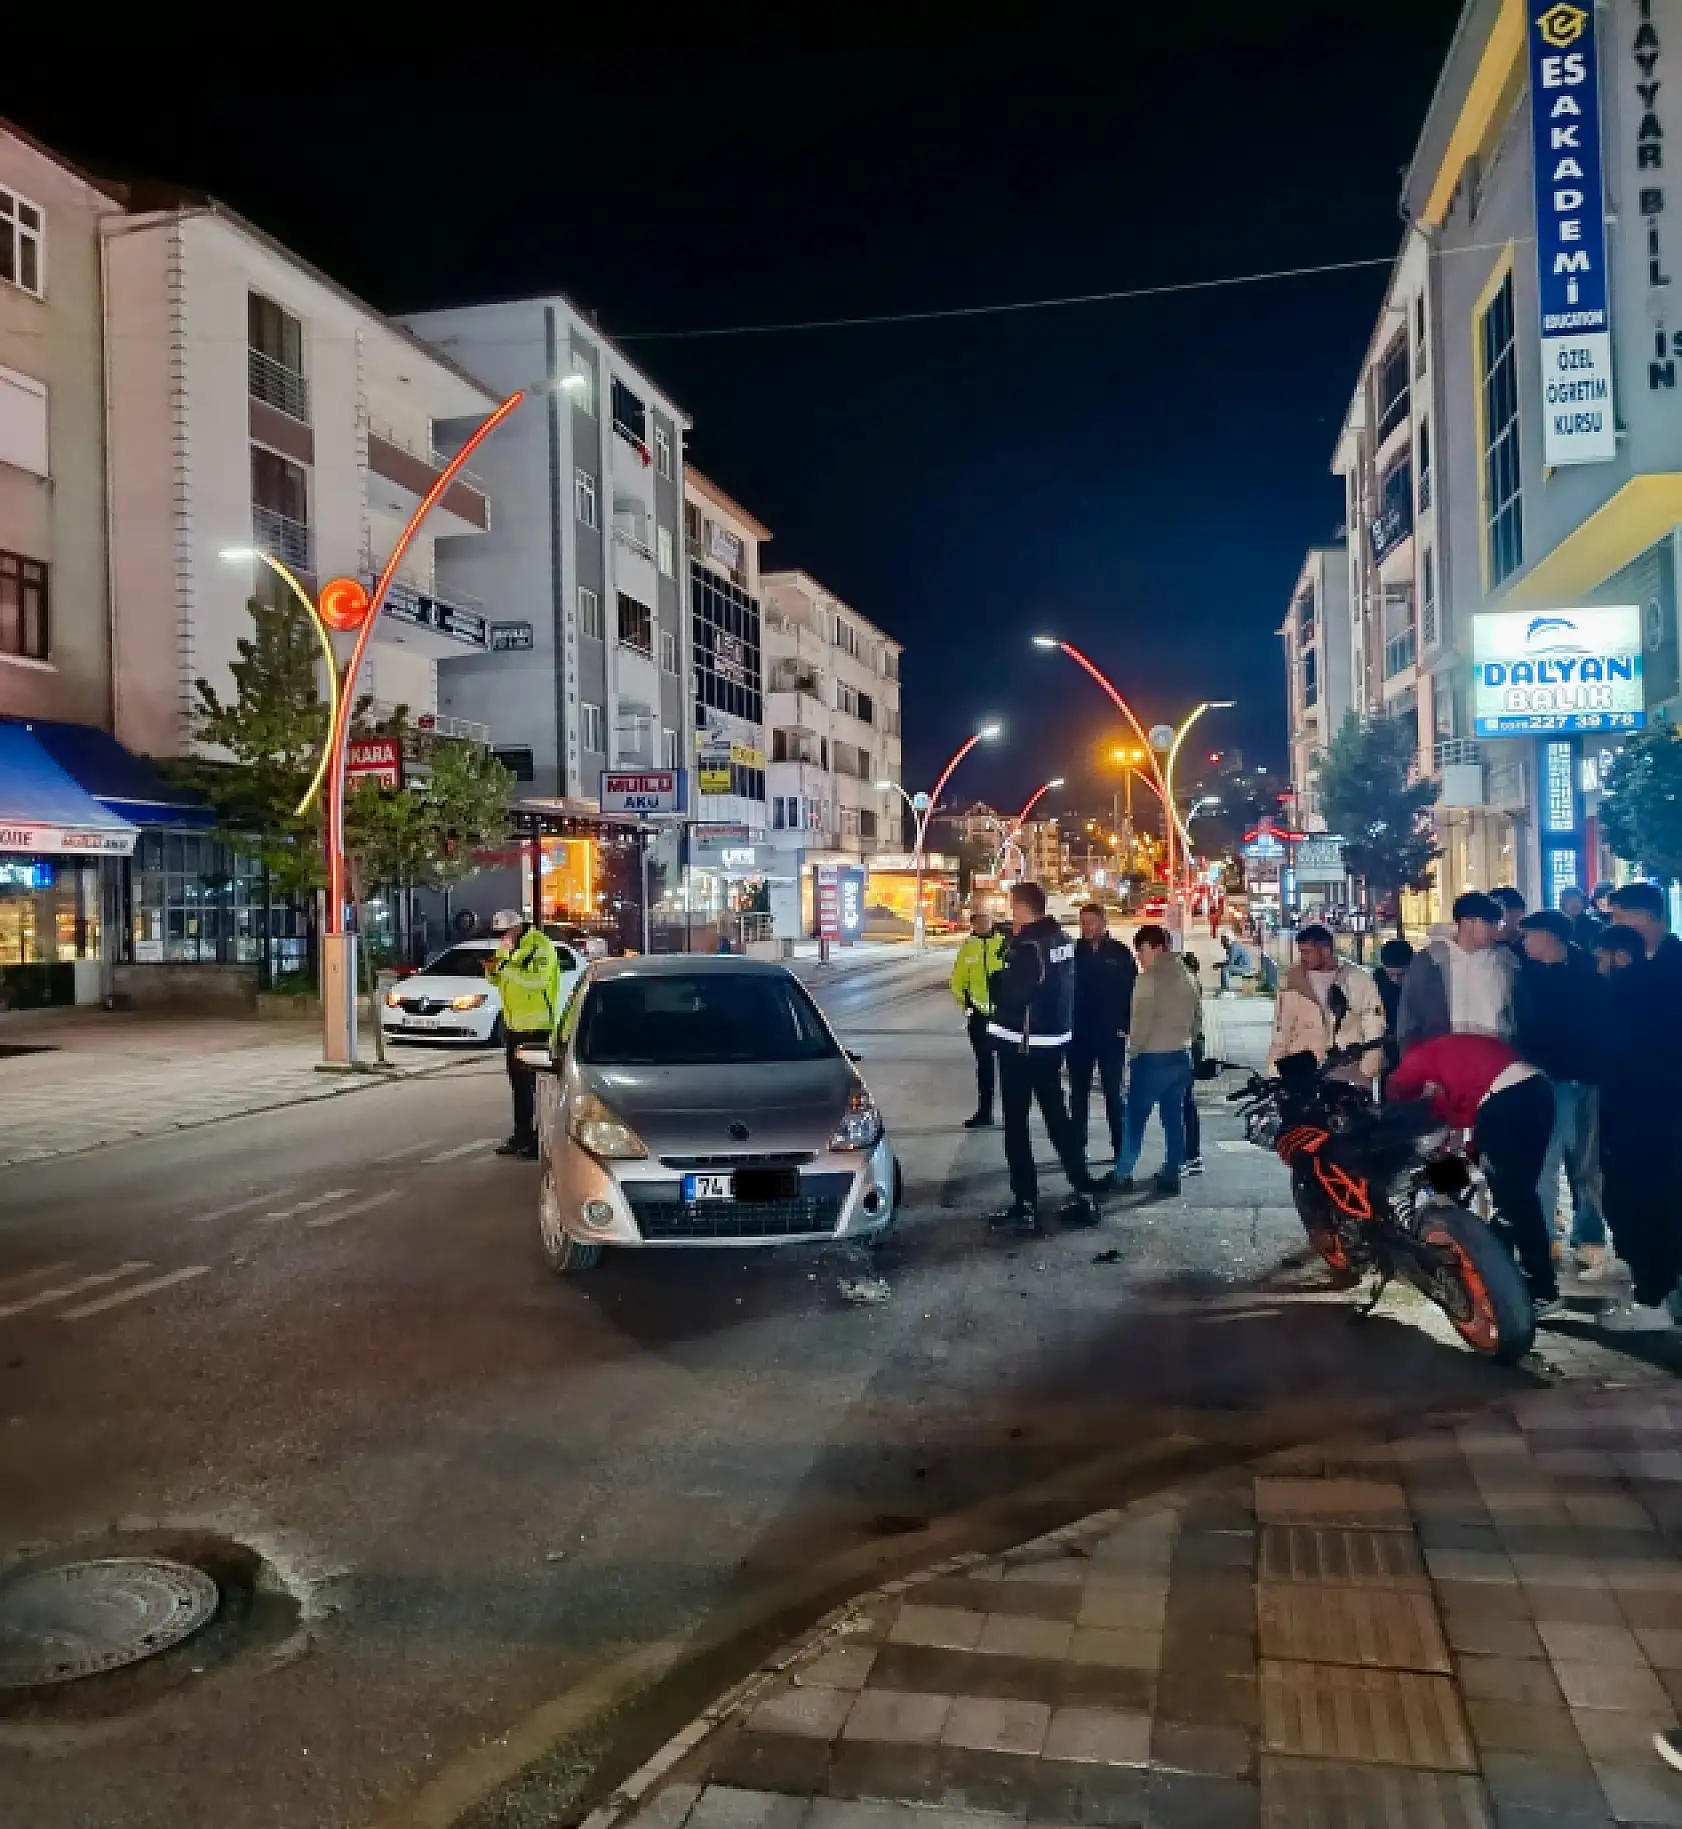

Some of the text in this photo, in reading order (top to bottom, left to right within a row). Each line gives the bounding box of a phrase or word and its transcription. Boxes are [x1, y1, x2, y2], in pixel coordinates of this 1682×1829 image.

[1541, 53, 1591, 305] ES AKADEMİ
[1557, 344, 1594, 371] ÖZEL
[1546, 373, 1608, 404] ÖĞRETİM
[1554, 410, 1602, 435] KURSU
[1484, 656, 1632, 687] DALYAN
[1505, 685, 1613, 713] BALIK
[697, 1177, 723, 1196] 74
